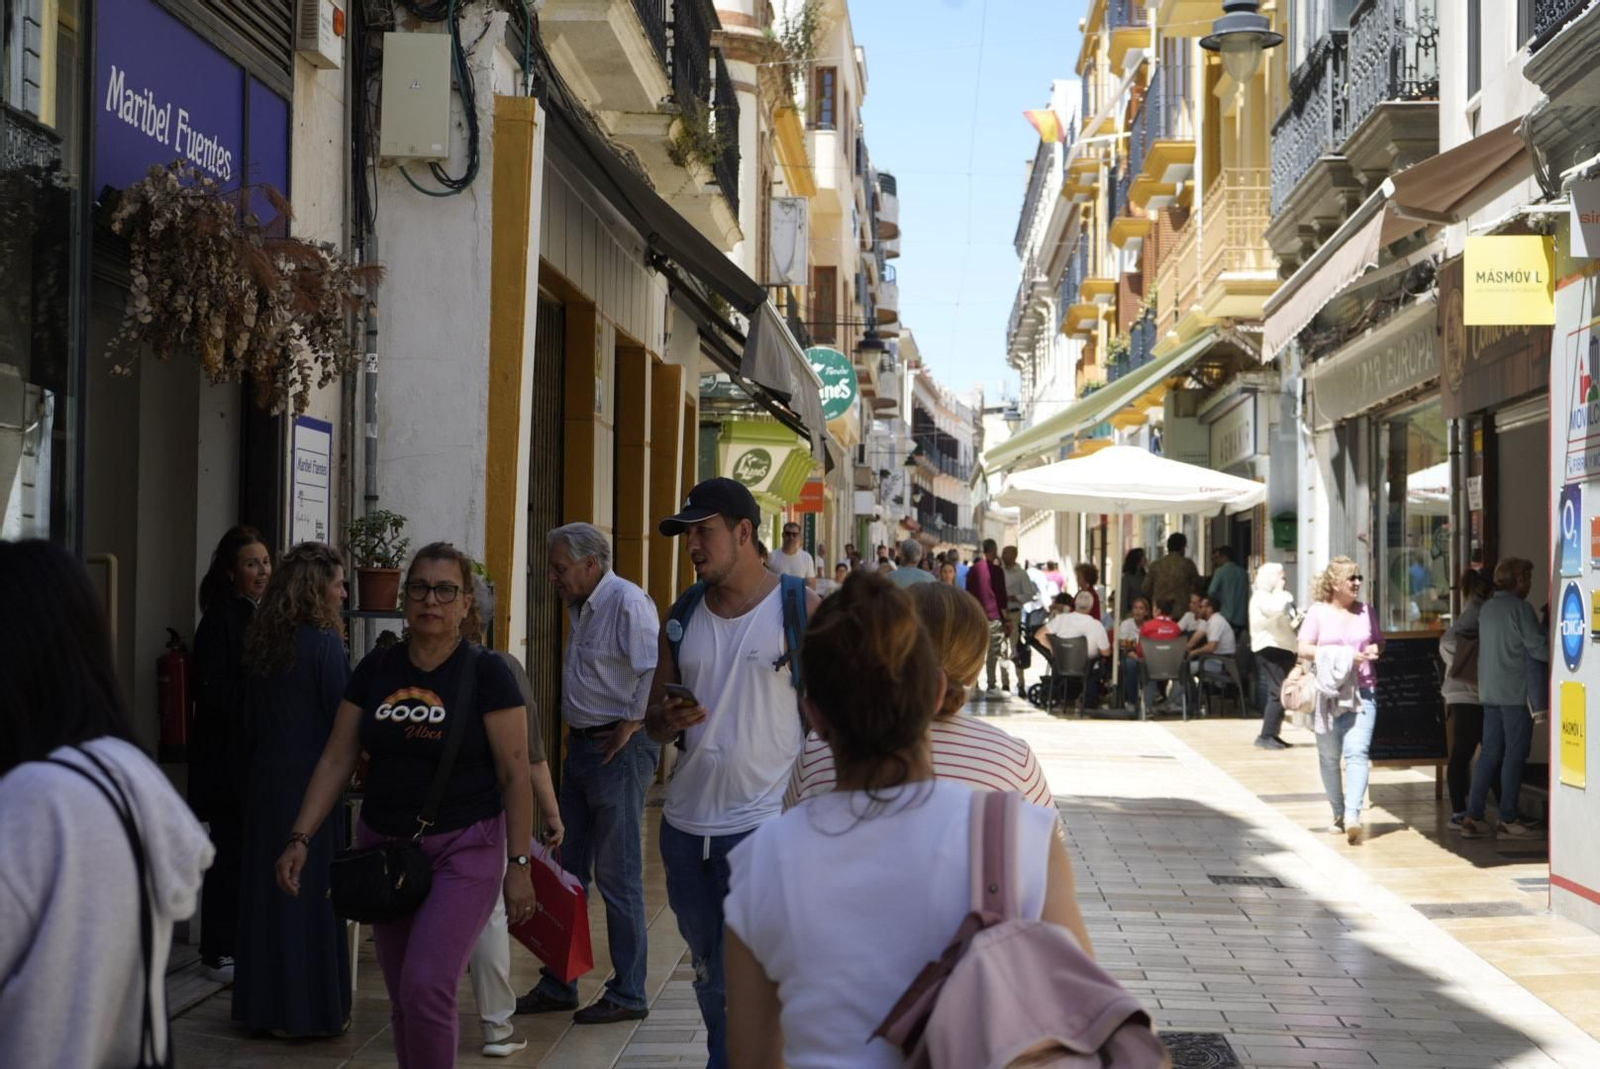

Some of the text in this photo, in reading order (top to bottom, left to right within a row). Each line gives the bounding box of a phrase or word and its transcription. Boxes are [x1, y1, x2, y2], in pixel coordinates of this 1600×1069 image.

[106, 65, 231, 181] Maribel Fuentes
[1387, 326, 1434, 386] EUROPA
[1563, 619, 1583, 636] DIGI
[375, 703, 446, 724] GOOD
